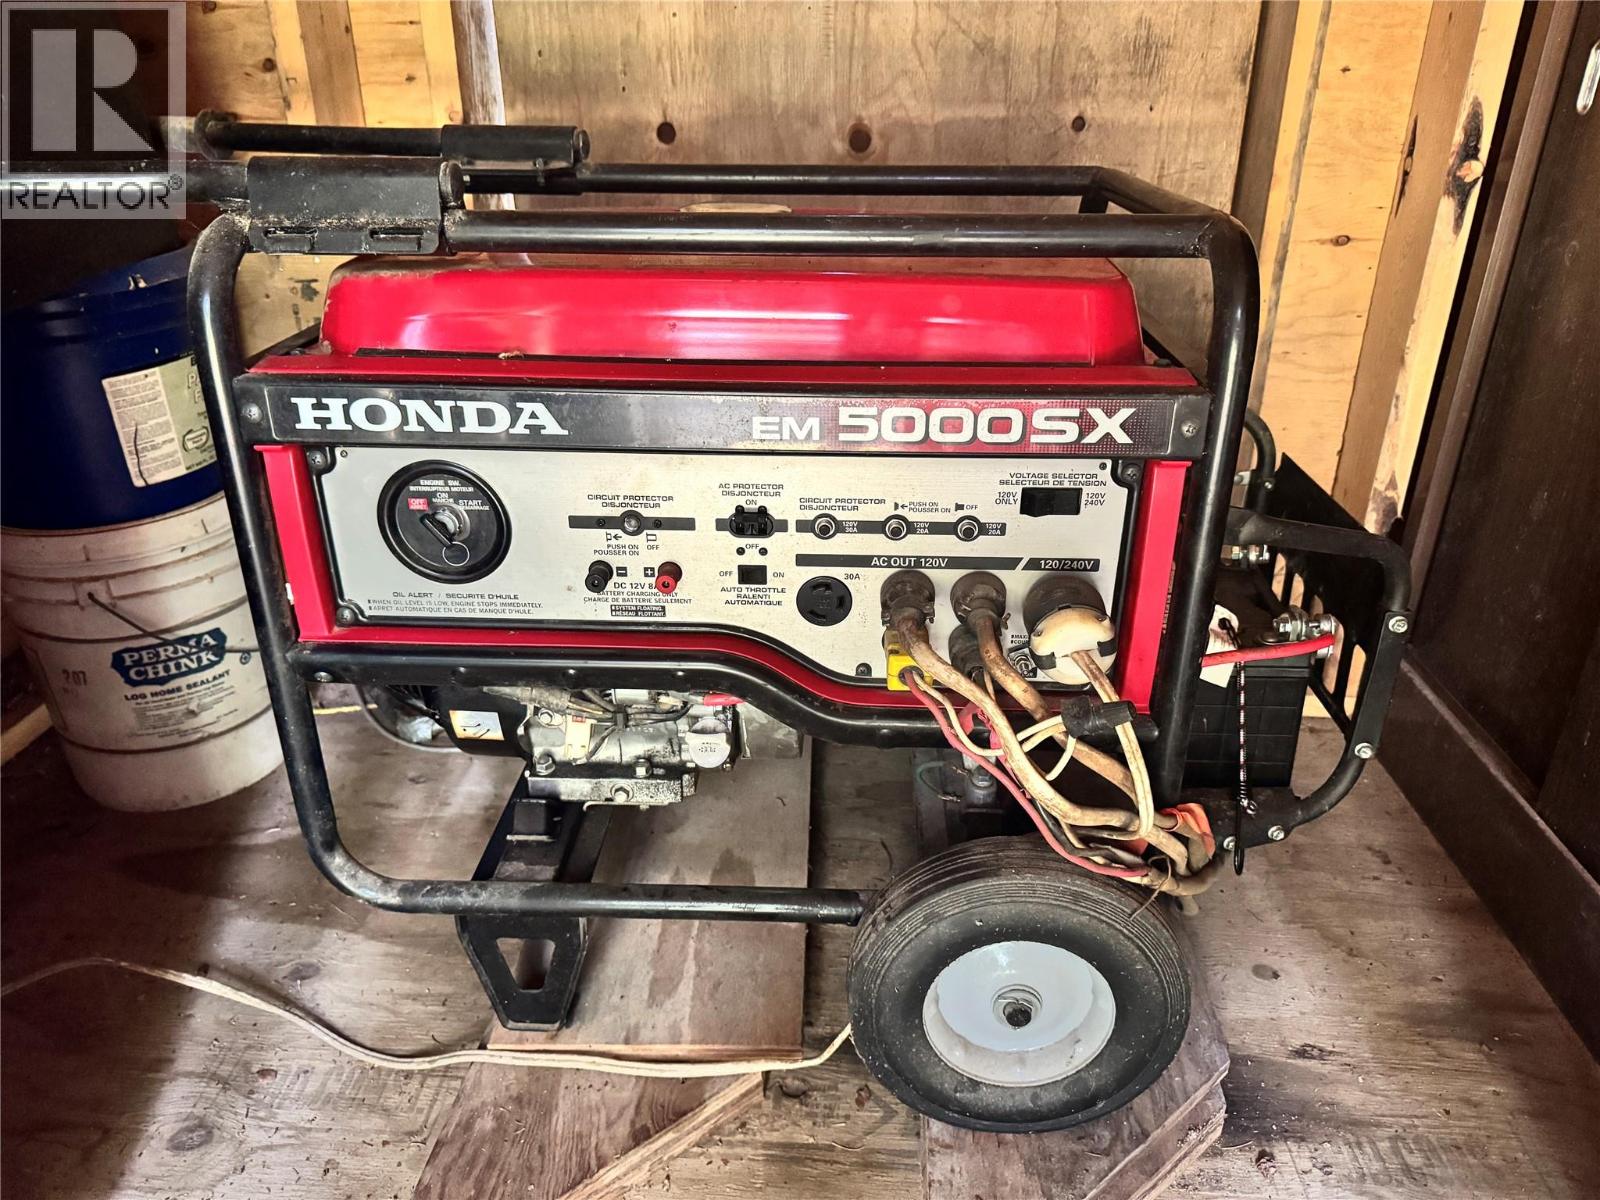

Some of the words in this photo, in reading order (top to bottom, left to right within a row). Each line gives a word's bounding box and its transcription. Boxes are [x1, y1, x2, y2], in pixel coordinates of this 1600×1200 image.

[291, 396, 569, 436] HONDA
[752, 416, 820, 441] EM
[837, 405, 1136, 444] 5000SX
[870, 556, 888, 566] AC
[890, 557, 916, 567] OUT
[920, 558, 948, 567] 120V
[1039, 560, 1094, 570] 120/240V
[122, 634, 217, 666] PERMA
[128, 649, 220, 680] CHINK
[124, 693, 148, 701] LOG
[150, 686, 183, 698] HOME
[186, 669, 230, 690] SEALANT
